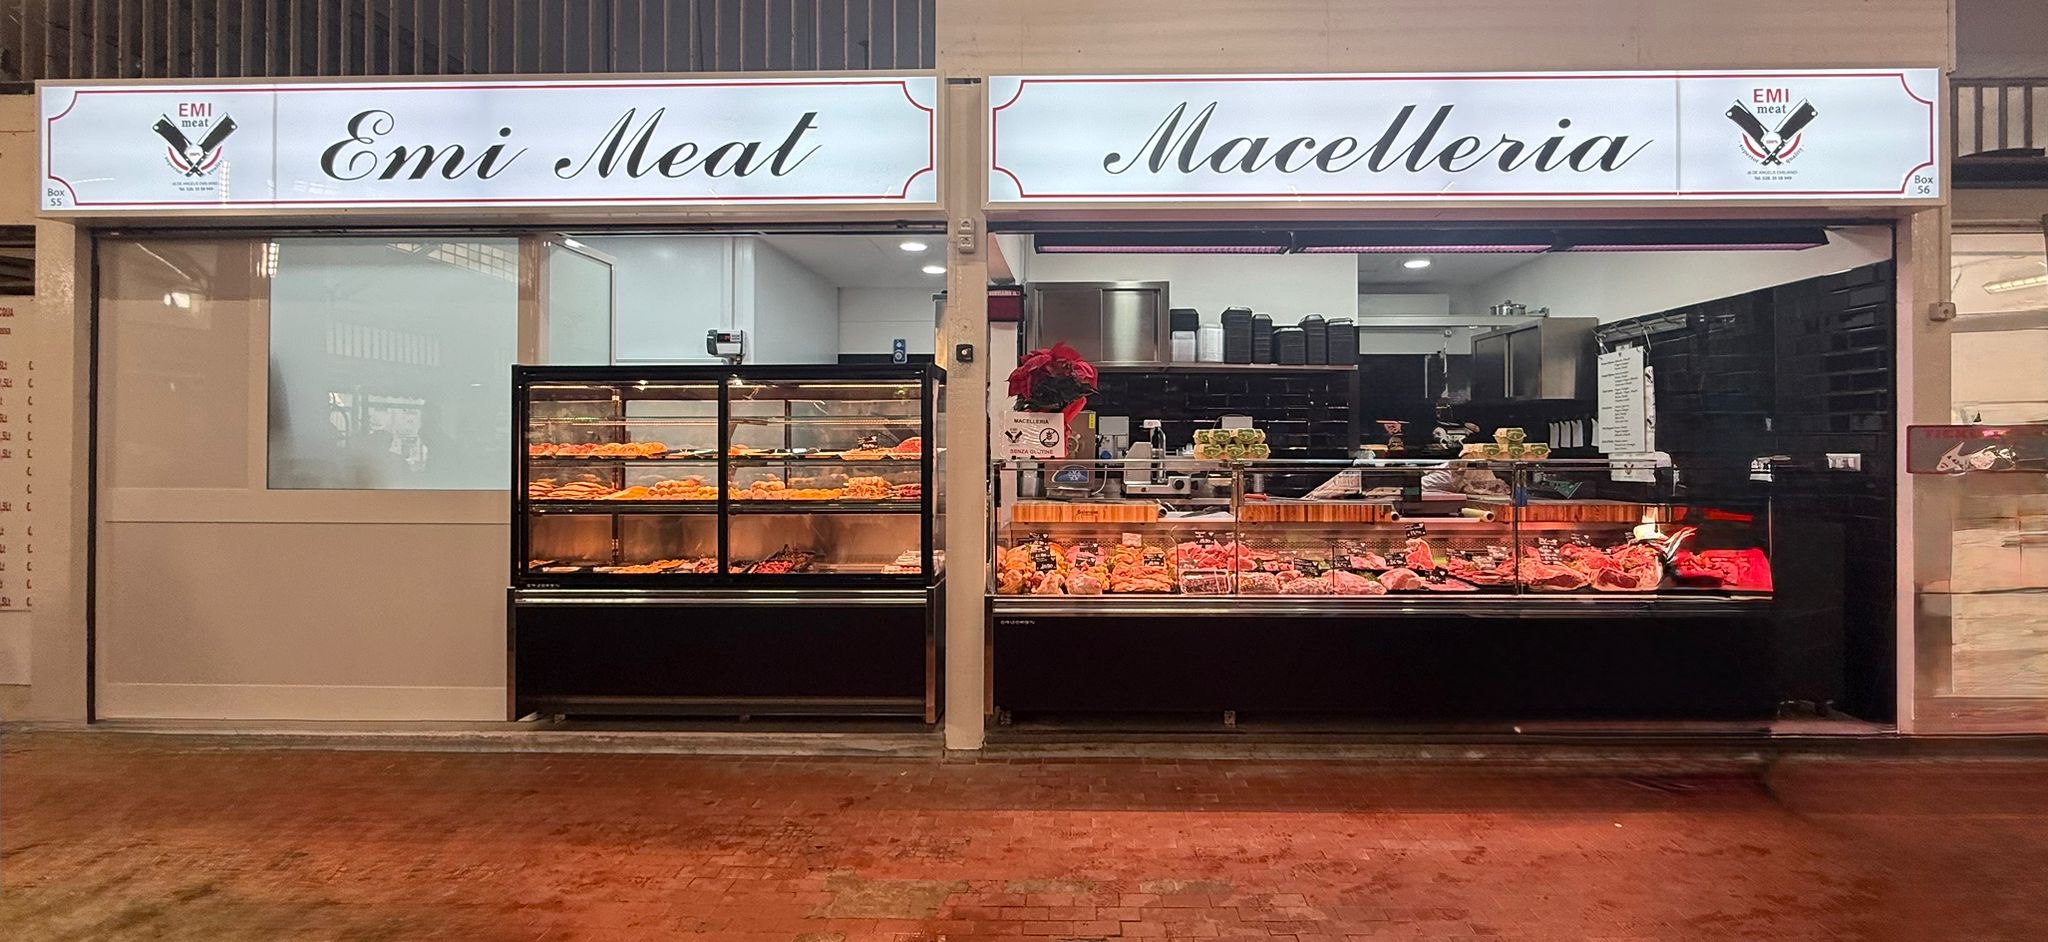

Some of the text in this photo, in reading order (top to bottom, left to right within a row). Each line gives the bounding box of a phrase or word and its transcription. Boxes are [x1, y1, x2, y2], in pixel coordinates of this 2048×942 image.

[1753, 88, 1789, 103] EMI
[178, 103, 212, 117] EMI
[1757, 104, 1787, 114] meat
[181, 118, 209, 127] meat
[1102, 100, 1655, 175] Macelleria
[320, 107, 823, 181] Emi Meat
[1914, 175, 1934, 184] Box
[47, 188, 65, 197] Box
[1917, 185, 1930, 194] 56
[50, 198, 62, 206] 55
